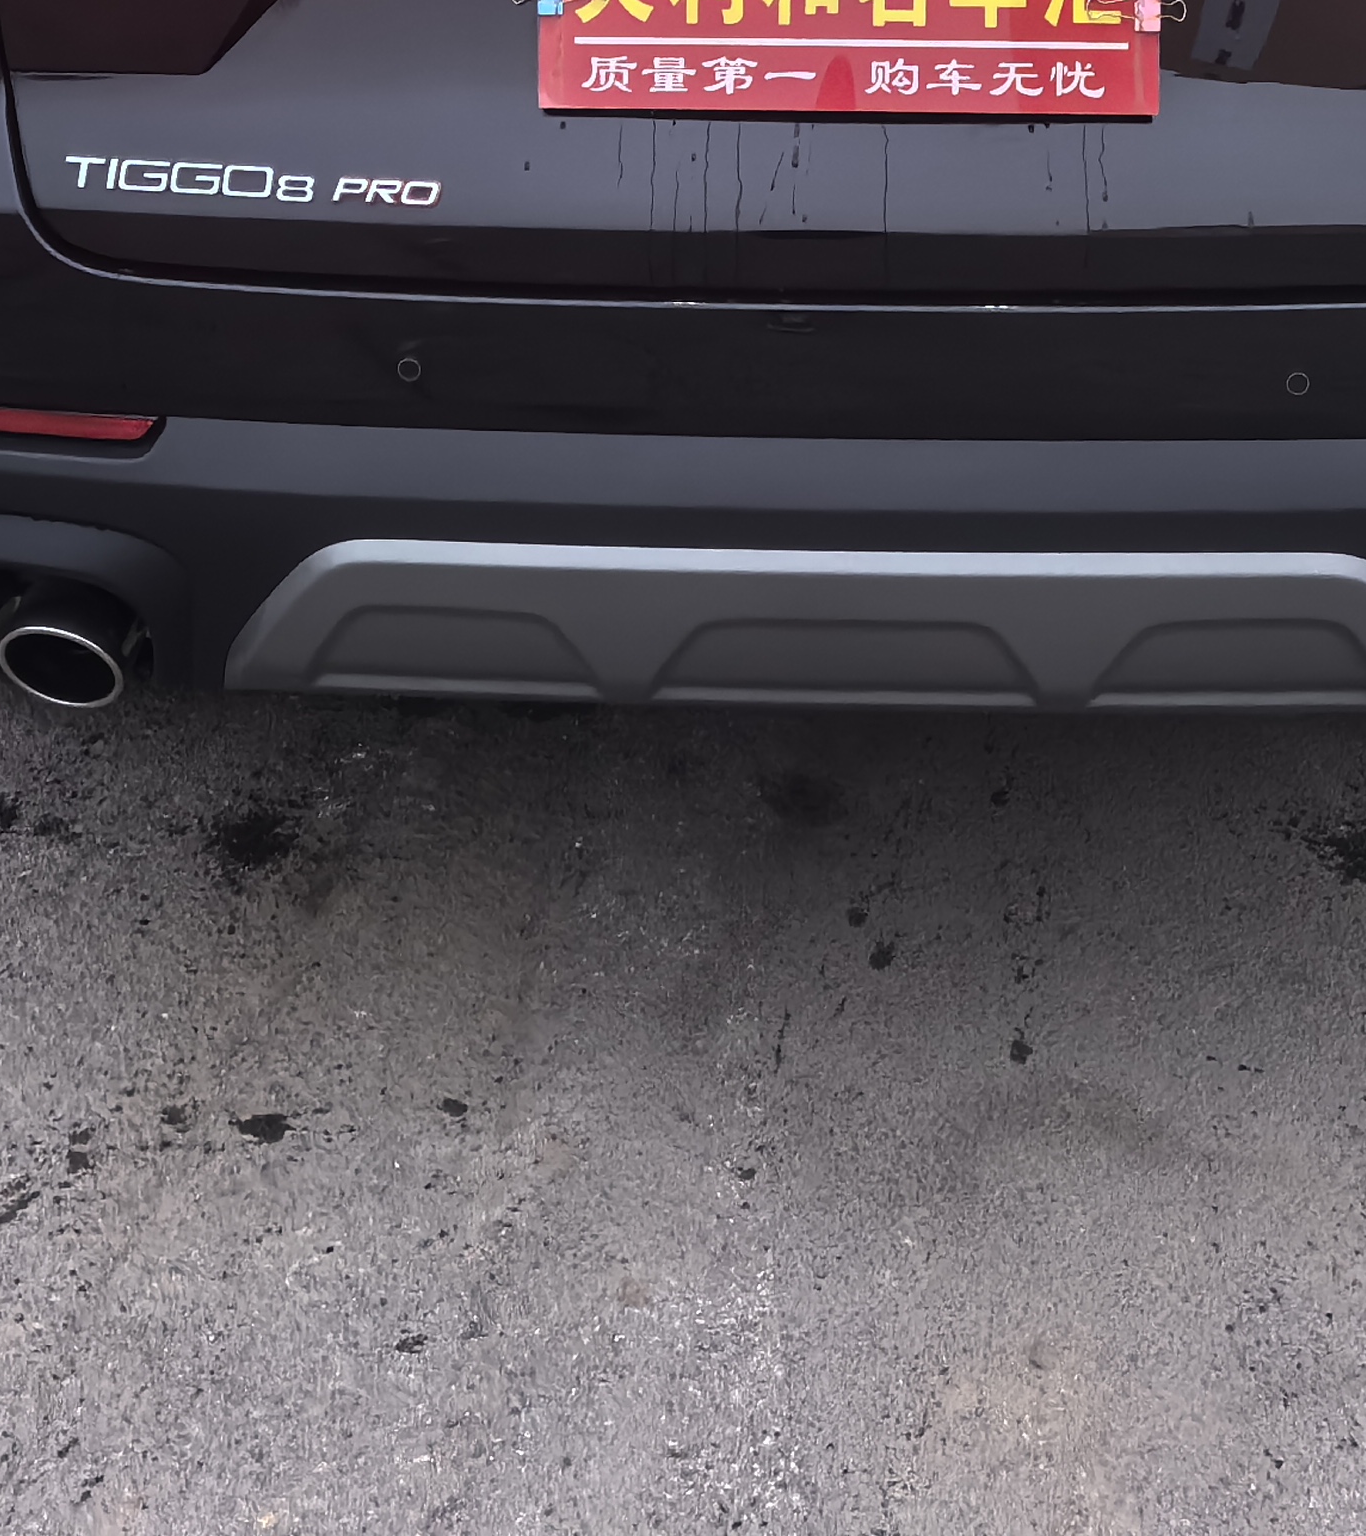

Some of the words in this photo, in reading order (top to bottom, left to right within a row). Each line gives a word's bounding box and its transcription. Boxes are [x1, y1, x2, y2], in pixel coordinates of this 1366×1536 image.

[581, 55, 817, 95] 质量第一
[864, 59, 1106, 98] 购车无忧
[332, 176, 442, 207] PRO
